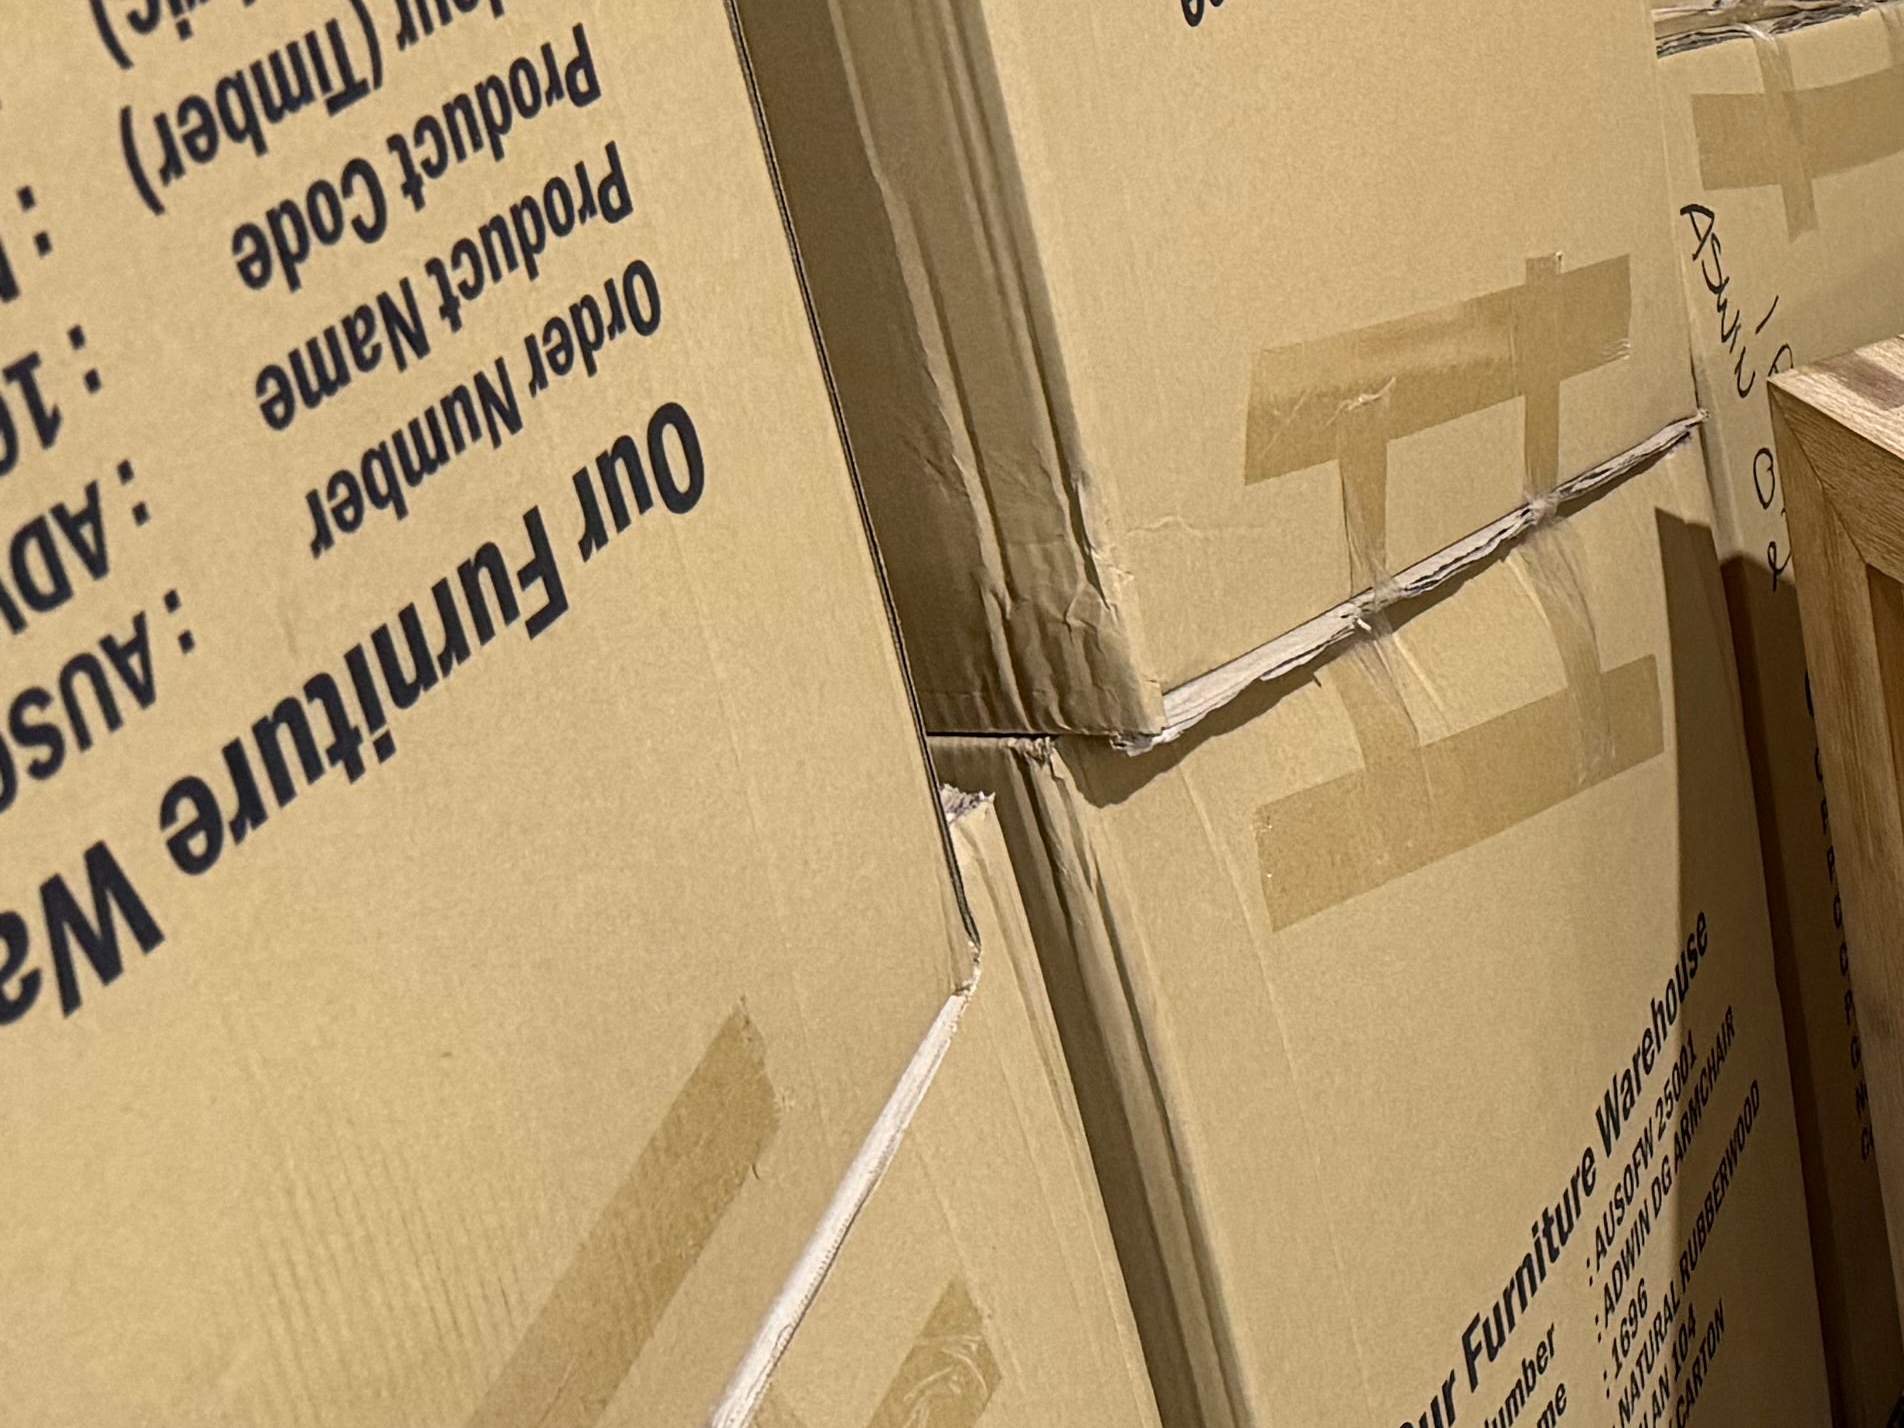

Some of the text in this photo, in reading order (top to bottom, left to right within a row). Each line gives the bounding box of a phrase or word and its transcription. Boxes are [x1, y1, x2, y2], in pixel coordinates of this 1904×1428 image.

[232, 23, 601, 292] Product Code
[425, 141, 633, 332] Product
[255, 277, 430, 430] Name
[524, 260, 661, 398] Order
[306, 357, 523, 559] Number
[572, 402, 704, 562] Our
[159, 505, 568, 875] Furniture
[1462, 1147, 1596, 1393] Furniture
[1596, 911, 1707, 1158] Warehouse
[1596, 1118, 1653, 1272] AUSOFW
[1656, 1030, 1696, 1140] 25001
[1604, 1200, 1650, 1328] ADWIN
[1652, 1156, 1671, 1217] DG
[1675, 1005, 1735, 1173] ARMCHAIR
[1679, 1080, 1759, 1294] RUBBERWOOD
[1612, 1279, 1647, 1379] 1696
